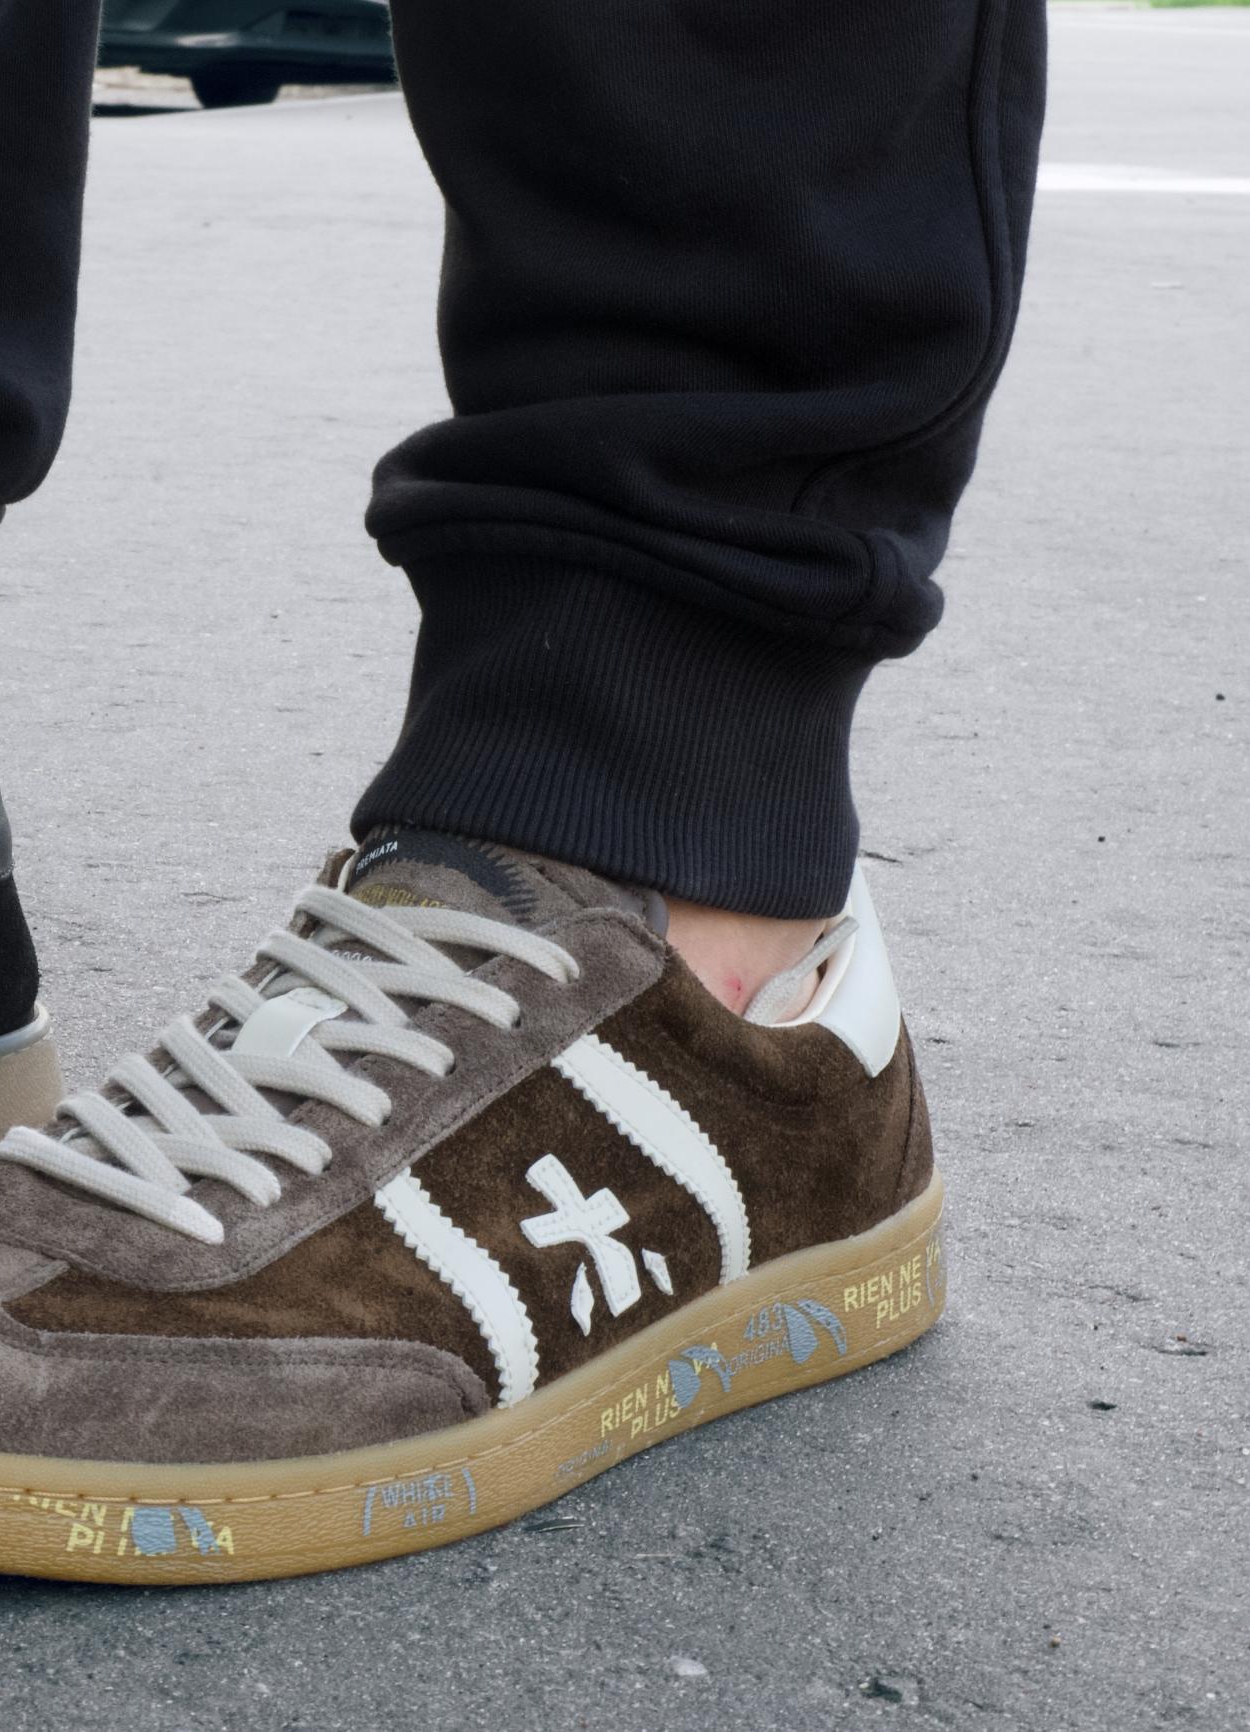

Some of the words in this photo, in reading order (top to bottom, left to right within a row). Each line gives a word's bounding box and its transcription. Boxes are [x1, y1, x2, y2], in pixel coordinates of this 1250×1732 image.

[356, 840, 399, 875] PREMIATA
[844, 1271, 894, 1312] RIEN
[900, 1255, 922, 1289] NE
[876, 1282, 922, 1329] PLUS
[729, 1335, 791, 1377] ORIGINA
[600, 1383, 648, 1438] RIEN
[630, 1394, 682, 1439] PLUS
[12, 1494, 107, 1526] IEN
[403, 1503, 446, 1528] AIR
